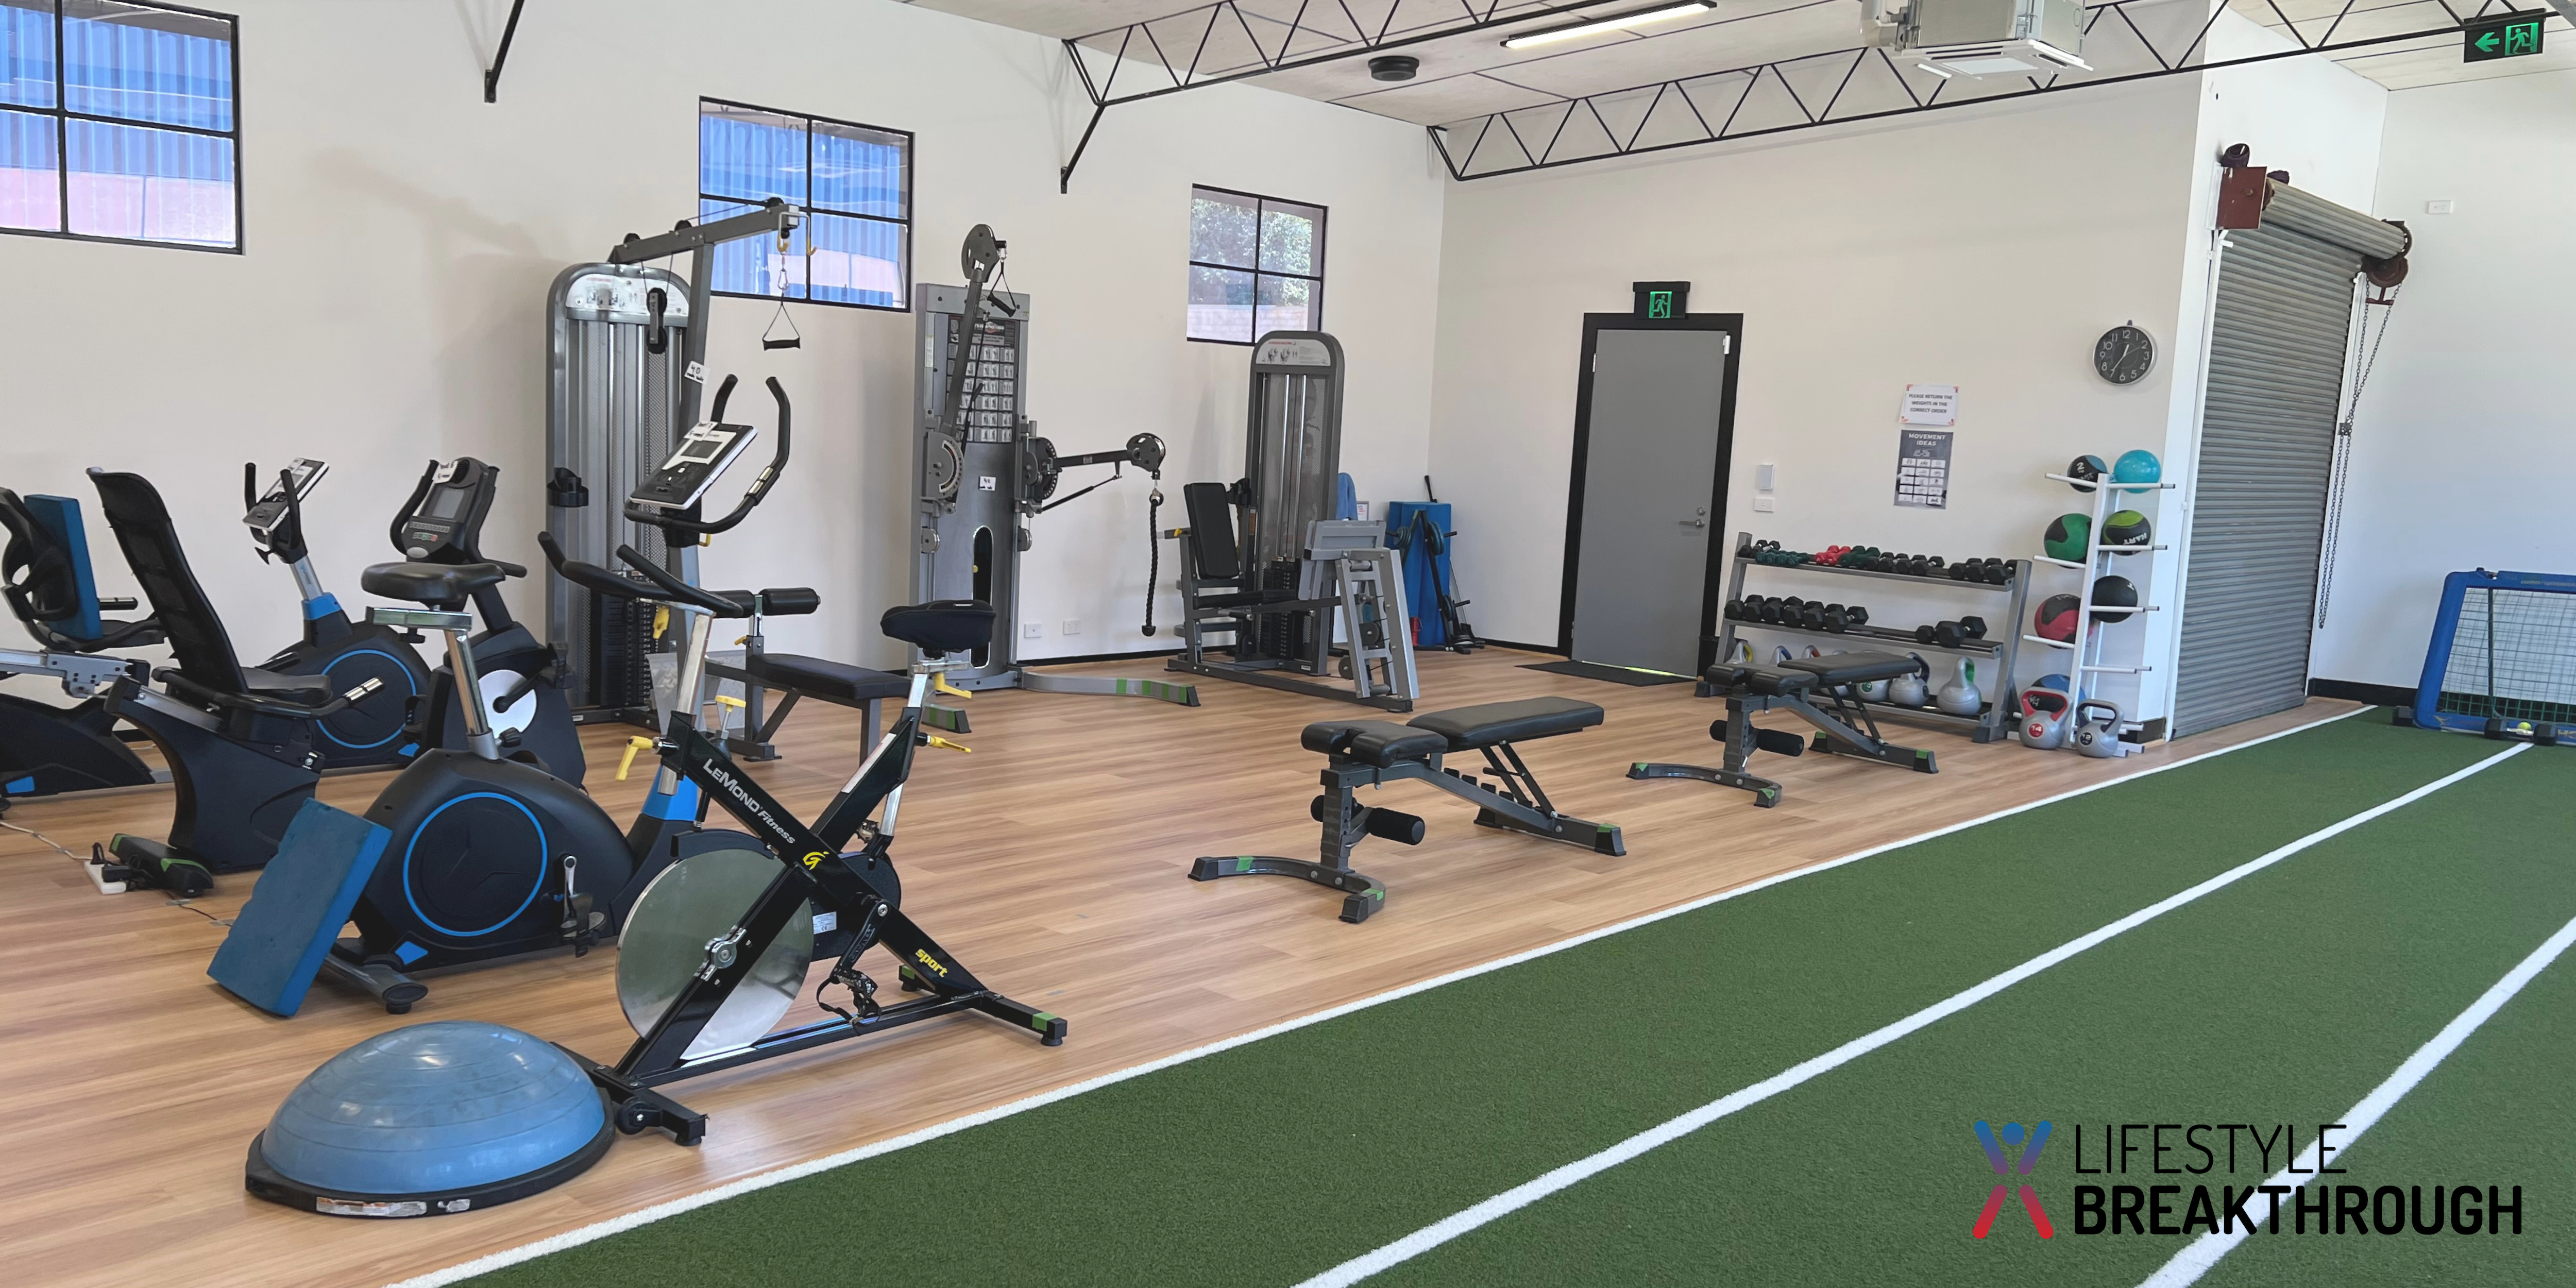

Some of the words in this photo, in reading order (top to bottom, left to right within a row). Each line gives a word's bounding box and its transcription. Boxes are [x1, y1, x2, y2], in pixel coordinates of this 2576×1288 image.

[2112, 333, 2118, 342] 11
[2122, 330, 2130, 338] 12
[2136, 332, 2139, 341] 1
[2103, 342, 2113, 350] 10
[2141, 341, 2148, 349] 2
[2099, 351, 2106, 360] 9
[2143, 351, 2149, 360] 3
[2102, 362, 2107, 371] 8
[2139, 362, 2145, 370] 4
[2119, 372, 2126, 381] 6
[2130, 370, 2137, 379] 5
[2076, 462, 2085, 471] 2
[2123, 532, 2147, 545] HART
[757, 810, 796, 844] Fitness
[915, 948, 948, 978] sport
